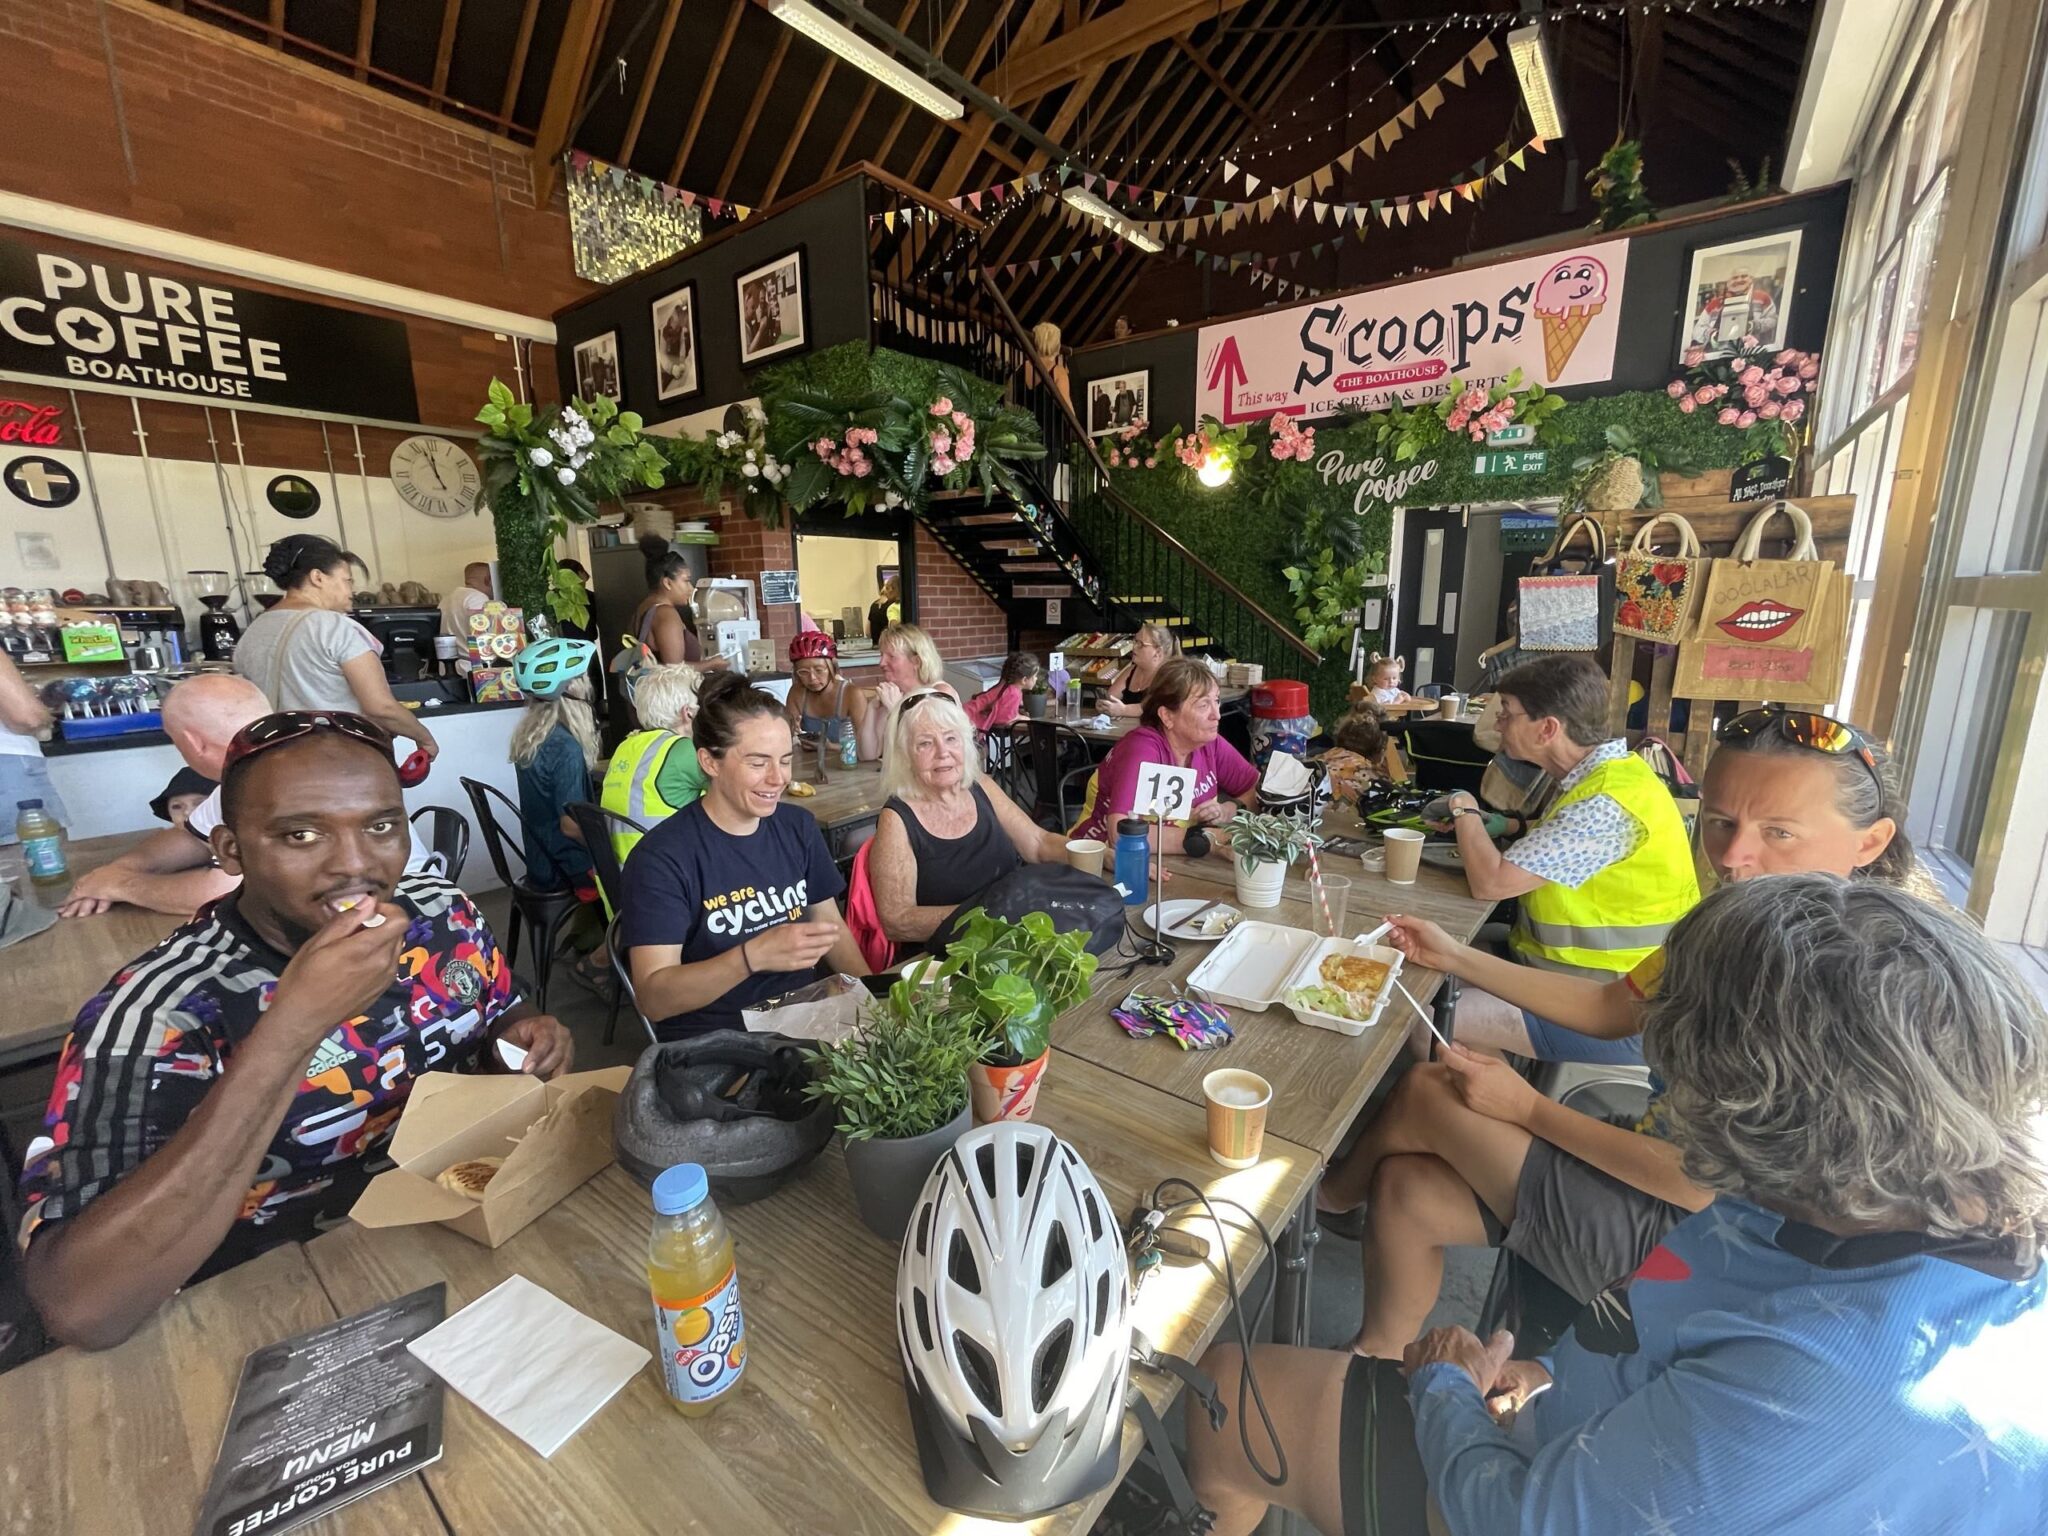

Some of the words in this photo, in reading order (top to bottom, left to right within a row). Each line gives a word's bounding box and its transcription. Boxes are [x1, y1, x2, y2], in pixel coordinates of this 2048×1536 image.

[37, 254, 240, 332] PURE
[0, 297, 287, 381] COFFEE
[1293, 282, 1535, 394] Scoops
[66, 356, 252, 397] BOATHOUSE
[1310, 399, 1335, 414] ICE
[1402, 388, 1415, 400] &
[1422, 375, 1509, 398] DESERTS
[1340, 376, 1363, 389] THE
[1366, 364, 1439, 383] BOATHOUSE
[1238, 391, 1263, 407] This
[1266, 391, 1288, 405] way
[0, 400, 63, 444] ola
[1316, 449, 1387, 486] Pure
[1522, 462, 1543, 471] EXIT
[1523, 452, 1545, 461] FIRE
[1353, 458, 1438, 516] Coffee
[1148, 772, 1185, 810] 13
[703, 894, 728, 911] we
[729, 886, 756, 902] are
[707, 879, 807, 936] cycling
[788, 905, 803, 921] UK
[305, 1050, 357, 1078] adidas
[689, 1282, 739, 1387] Oasis
[678, 1350, 693, 1366] NEW
[282, 1421, 376, 1481] MENU
[344, 1441, 412, 1484] PURE
[294, 1458, 358, 1492] BOATHOUSE
[228, 1478, 337, 1536] COFFEE
